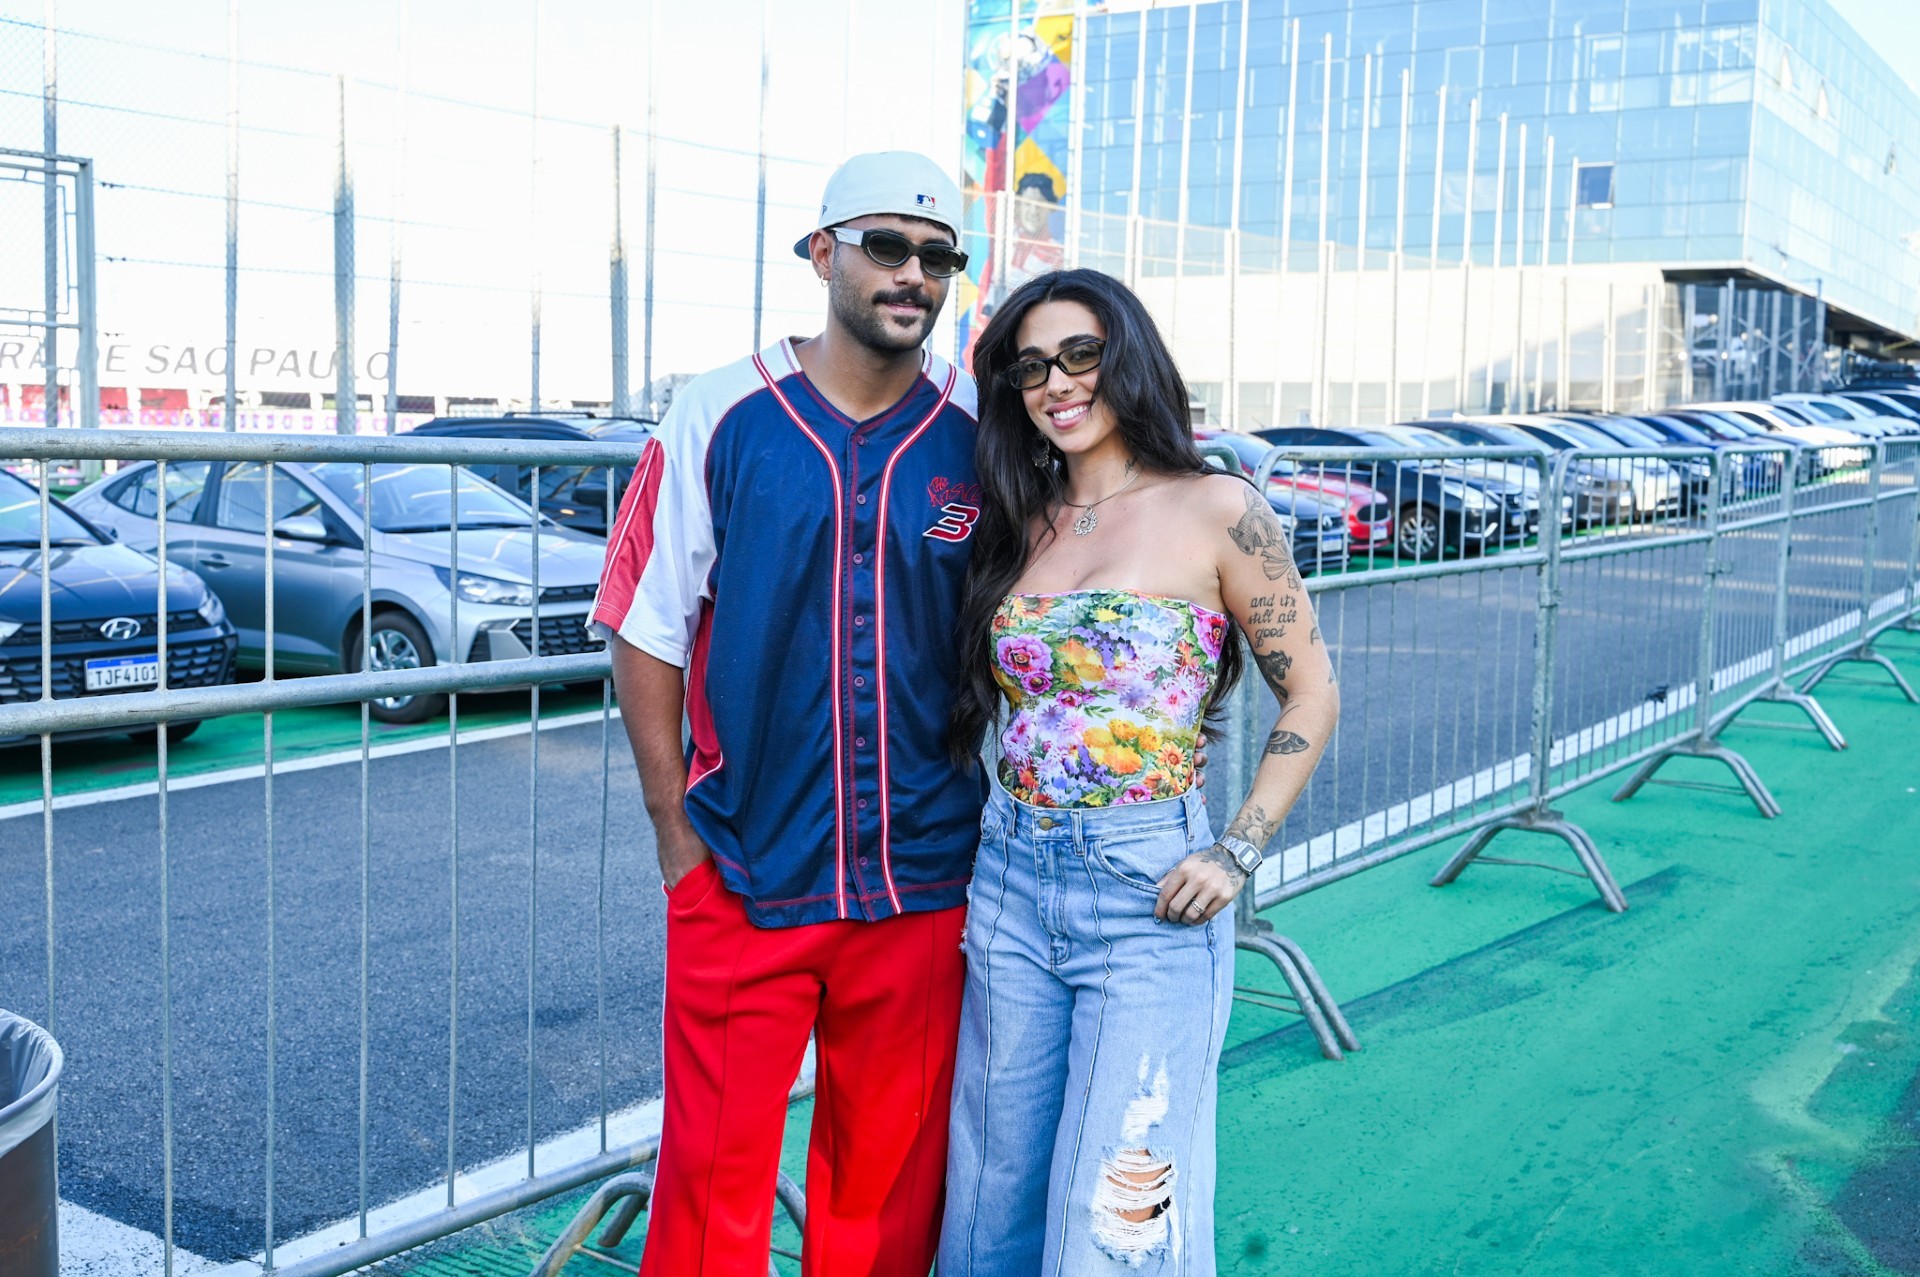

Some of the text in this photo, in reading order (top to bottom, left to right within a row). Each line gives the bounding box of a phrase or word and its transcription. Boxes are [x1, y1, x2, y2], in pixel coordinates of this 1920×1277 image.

[75, 345, 131, 373] E
[250, 348, 390, 380] PAUO
[922, 502, 980, 542] 3
[1250, 594, 1275, 608] and
[1247, 609, 1297, 624] still all
[1255, 625, 1286, 648] good
